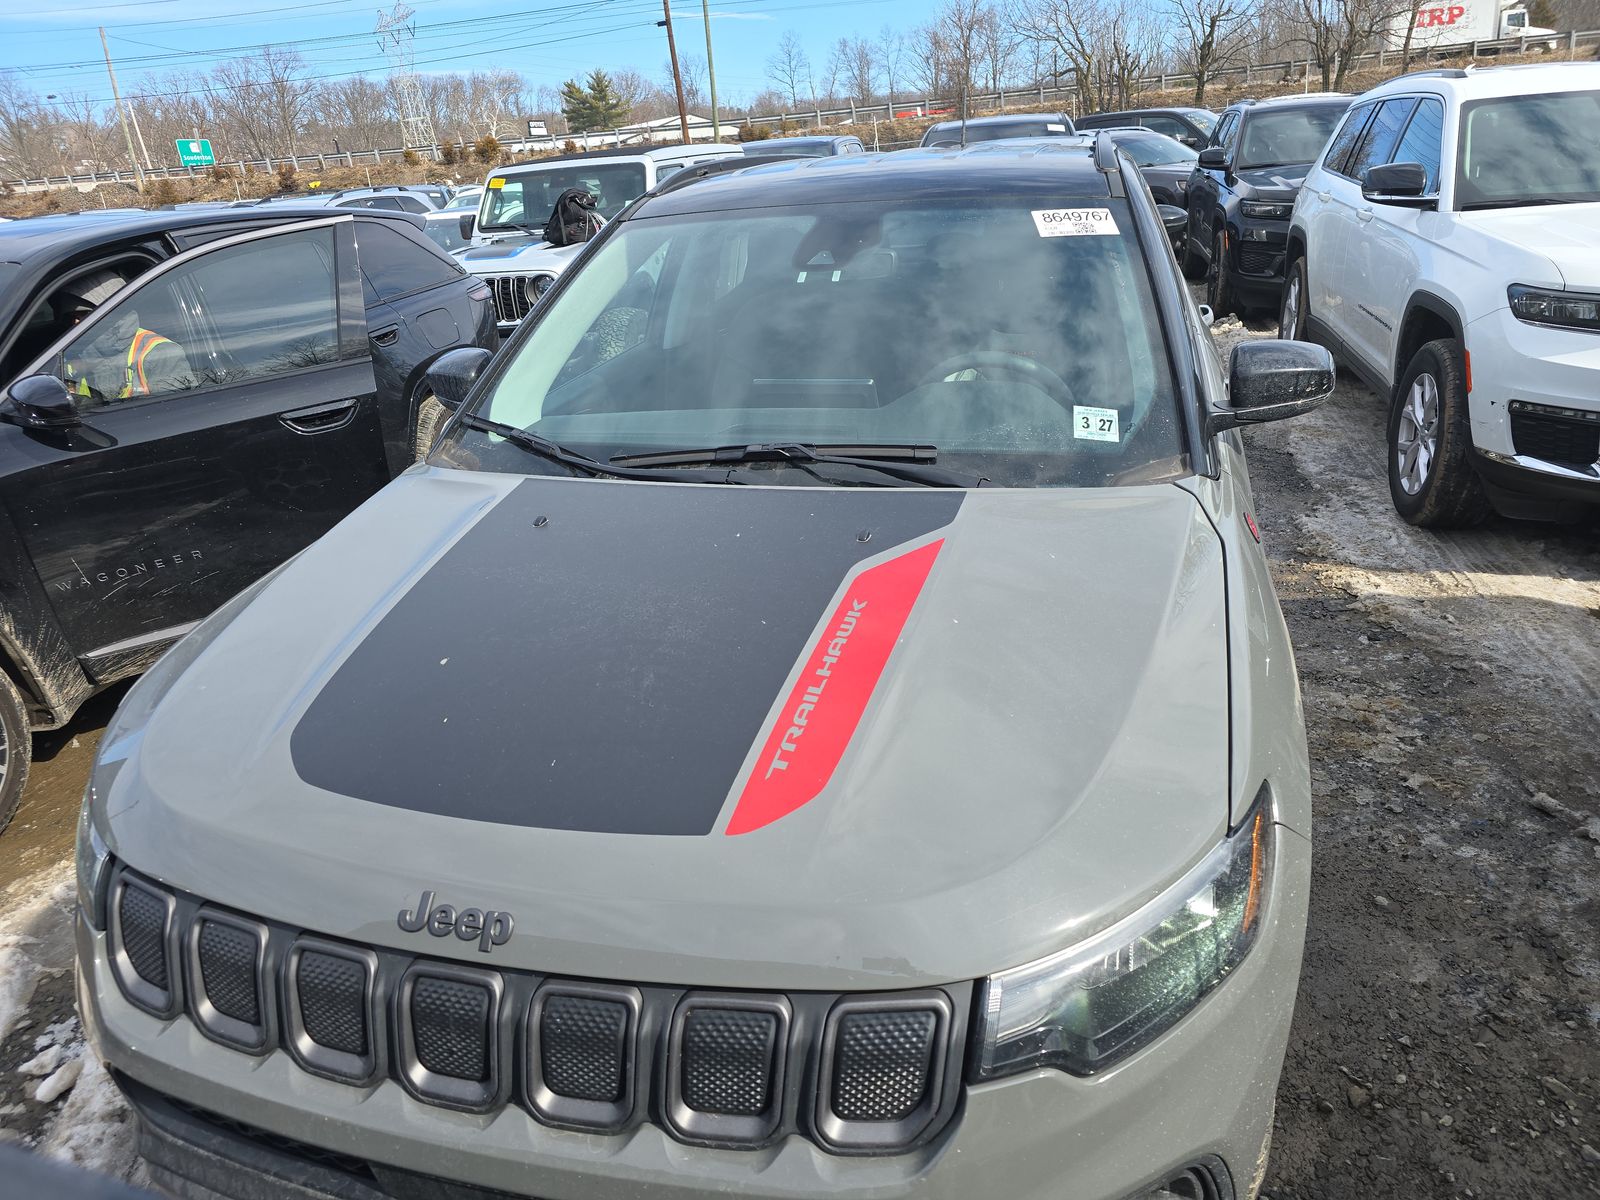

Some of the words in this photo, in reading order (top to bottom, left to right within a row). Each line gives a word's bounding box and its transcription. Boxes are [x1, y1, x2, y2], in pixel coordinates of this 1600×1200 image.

[1042, 211, 1109, 223] 8649767
[1082, 416, 1090, 429] 3
[1098, 418, 1113, 432] 27
[55, 550, 203, 592] WAGONEER
[765, 598, 868, 780] TRAILHAWK
[397, 890, 515, 953] Jeep
